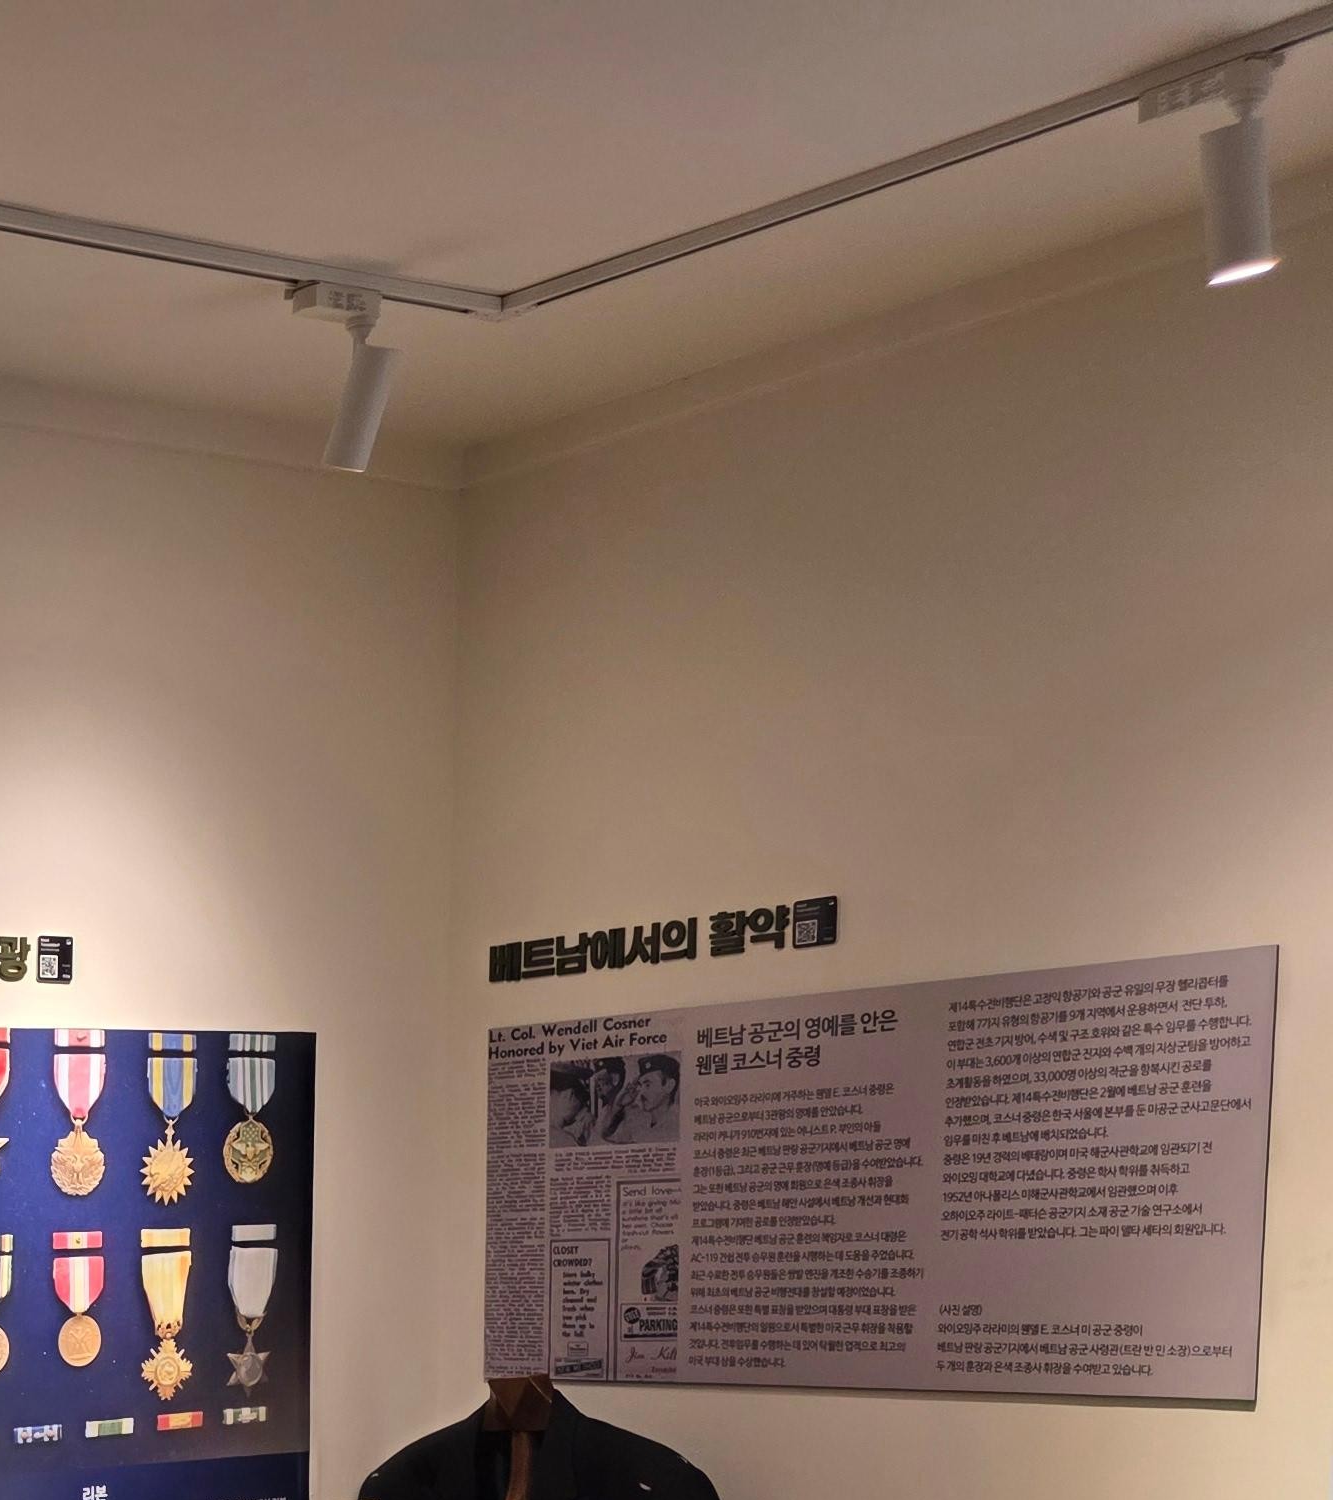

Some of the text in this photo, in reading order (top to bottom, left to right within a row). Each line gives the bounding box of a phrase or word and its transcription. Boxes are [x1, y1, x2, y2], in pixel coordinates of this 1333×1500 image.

[489, 904, 790, 983] 베트남에서의 활약
[489, 1018, 651, 1043] Lt. Col. Wendell Cosner
[696, 1009, 898, 1048] 베트남 공군의 영예를 안은
[488, 1032, 668, 1060] Honored by Viet Air Force
[695, 1045, 821, 1076] 웬델 코스너 중령
